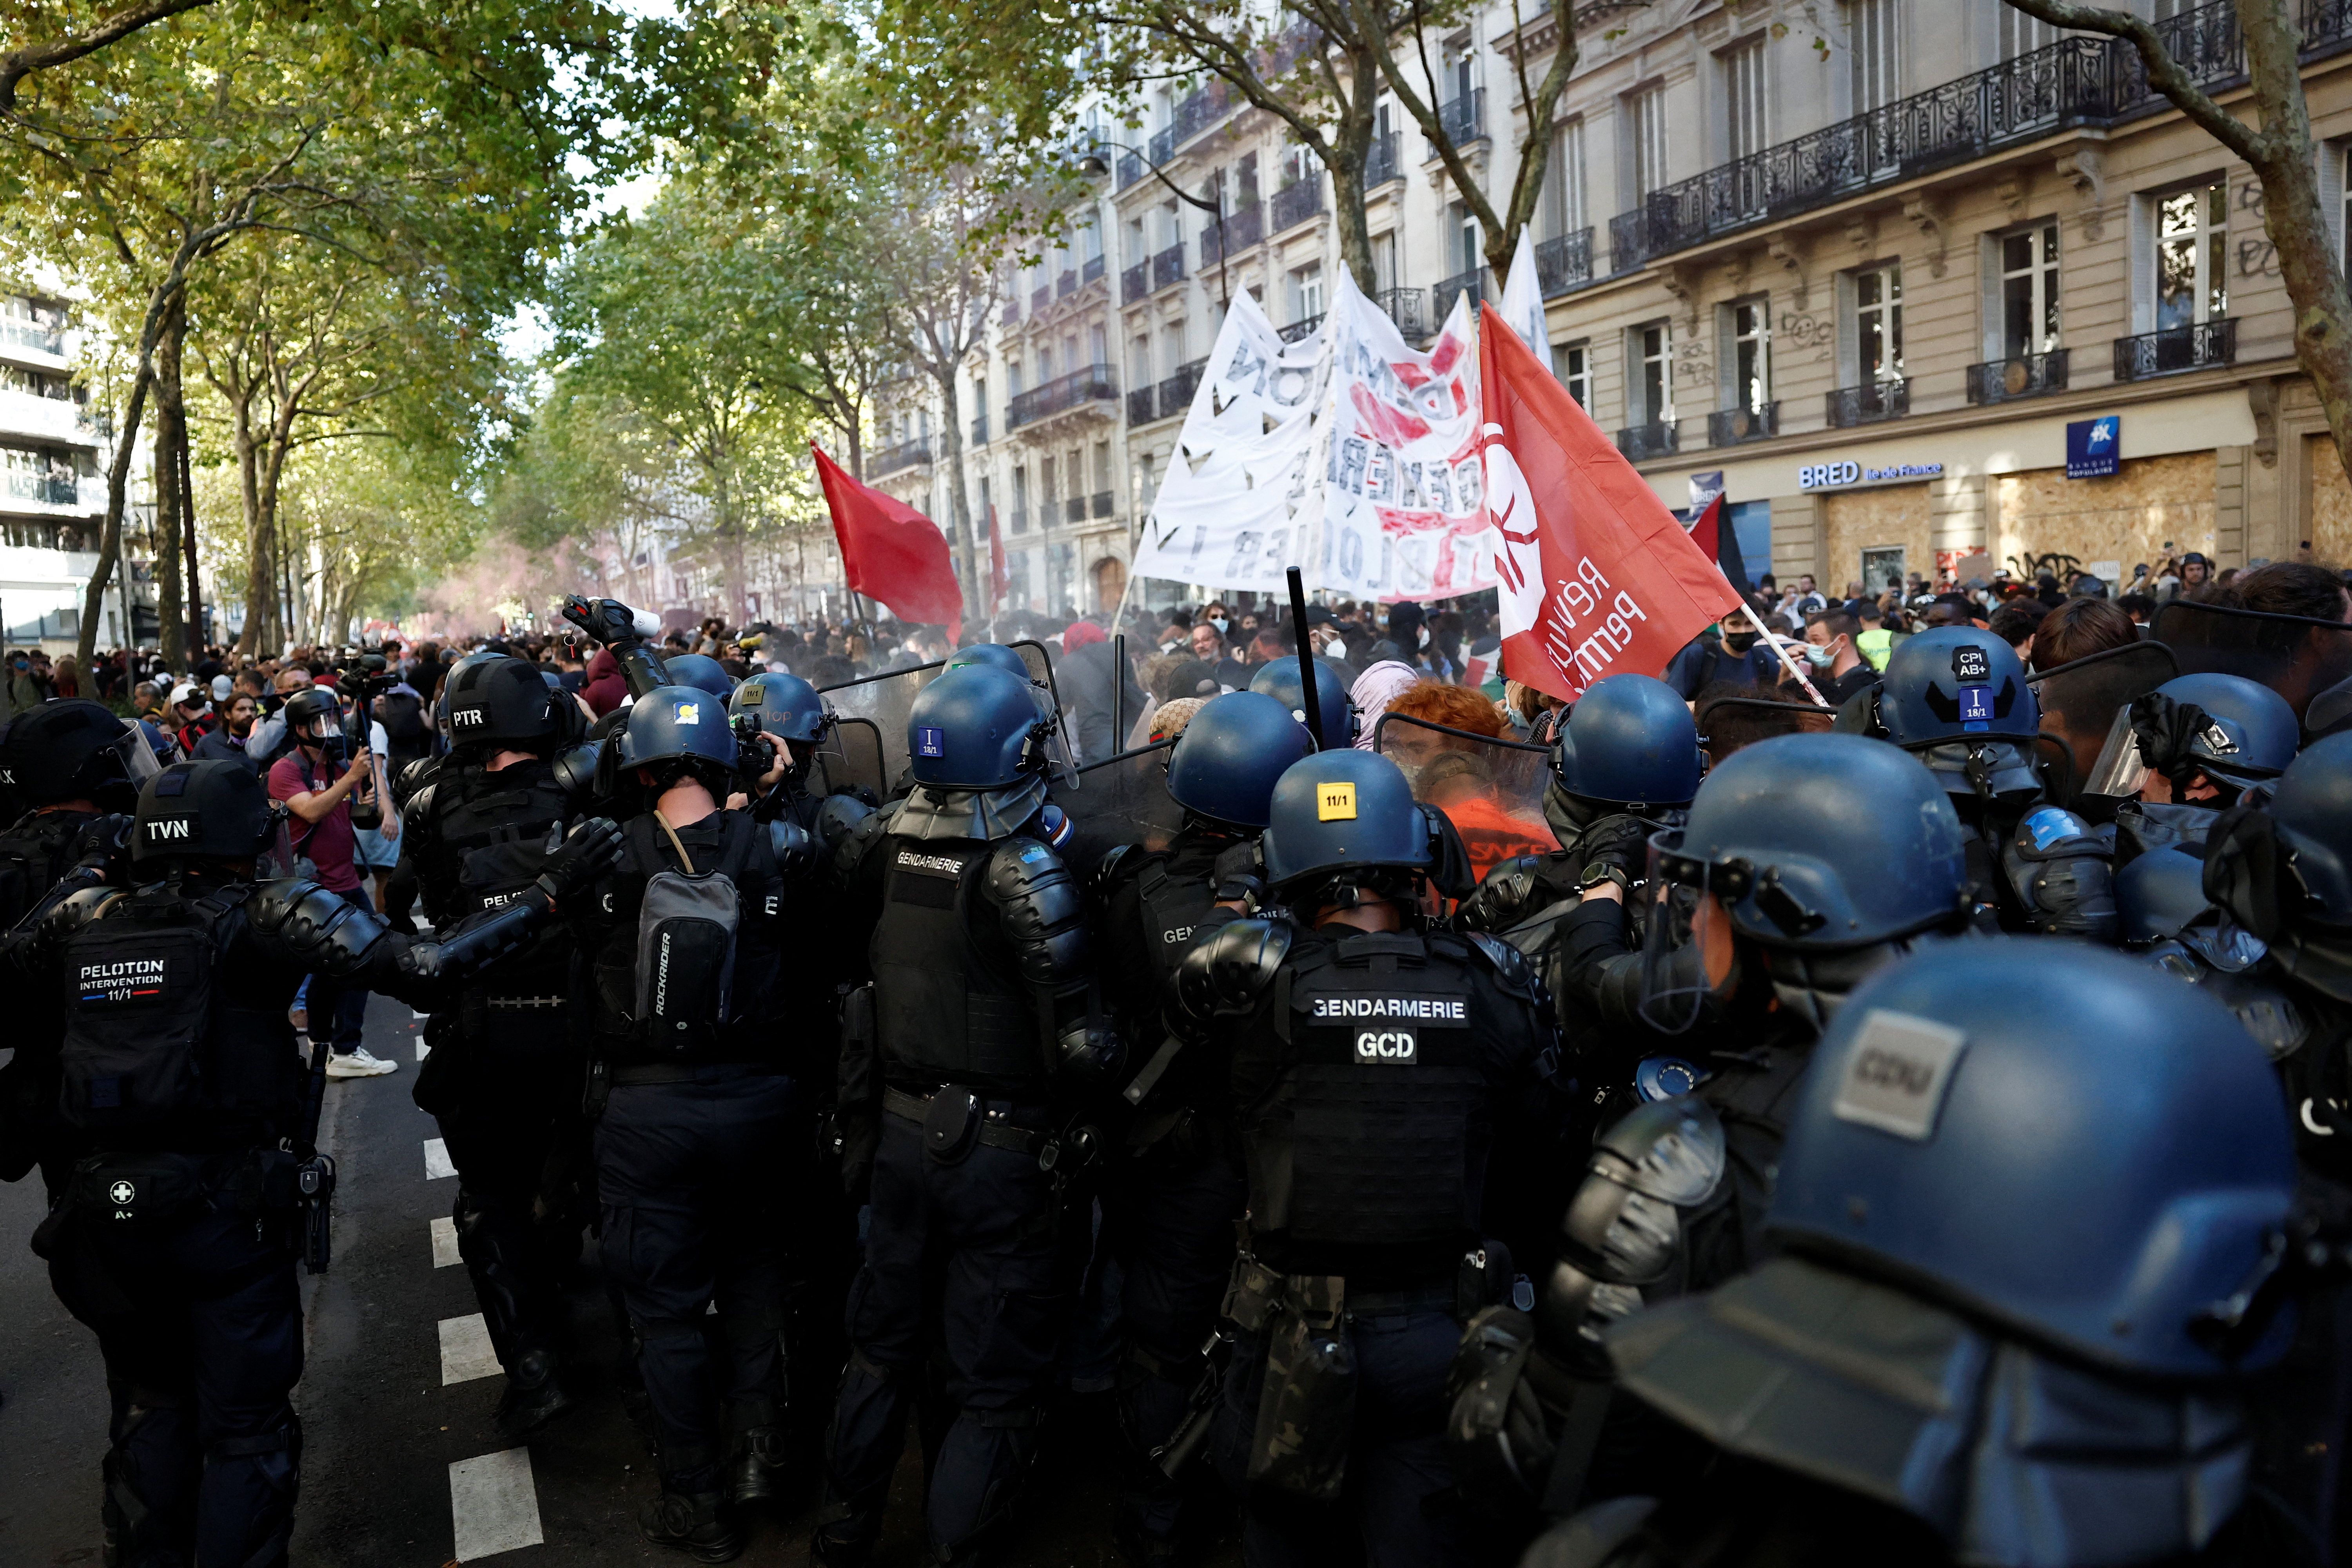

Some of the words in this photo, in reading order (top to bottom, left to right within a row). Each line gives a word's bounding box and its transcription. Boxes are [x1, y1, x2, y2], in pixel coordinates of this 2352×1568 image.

[1799, 460, 1858, 488] BRED
[1898, 463, 1941, 477] France
[1960, 653, 1982, 663] CPI
[1960, 664, 1986, 676] AB+
[454, 710, 483, 726] PTR
[1967, 708, 1986, 717] 18/1
[923, 746, 937, 754] 18/1
[1327, 795, 1347, 806] 11/1
[147, 820, 188, 840] TVN
[898, 851, 963, 873] GENDARMERIE
[81, 960, 164, 979] PELOTON
[656, 932, 671, 1016] ROCKRIDER
[80, 975, 163, 990] INTERVENTION
[108, 988, 131, 1001] 11/1
[1313, 998, 1465, 1019] GENDARMERIE
[1357, 1032, 1414, 1058] GCD
